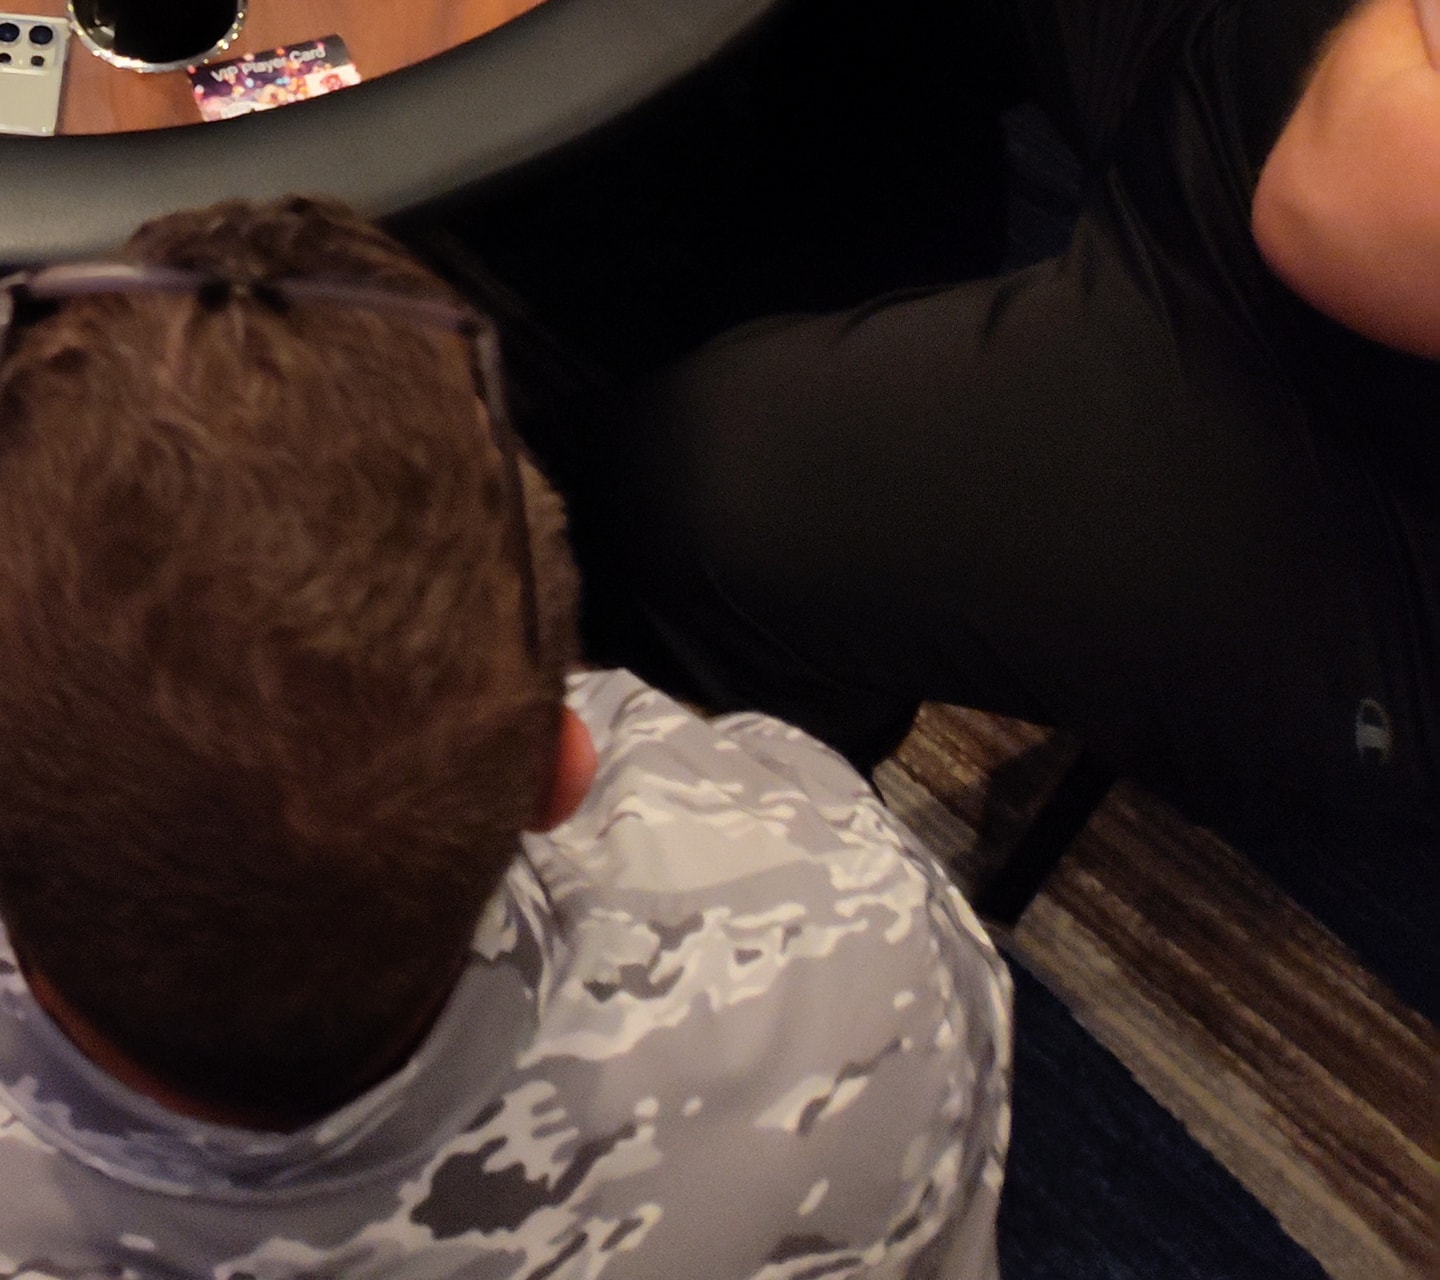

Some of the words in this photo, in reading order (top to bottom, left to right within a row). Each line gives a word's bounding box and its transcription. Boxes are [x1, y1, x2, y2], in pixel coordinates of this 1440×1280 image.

[210, 64, 240, 83] VIP
[241, 55, 288, 76] Player
[289, 45, 327, 65] Card
